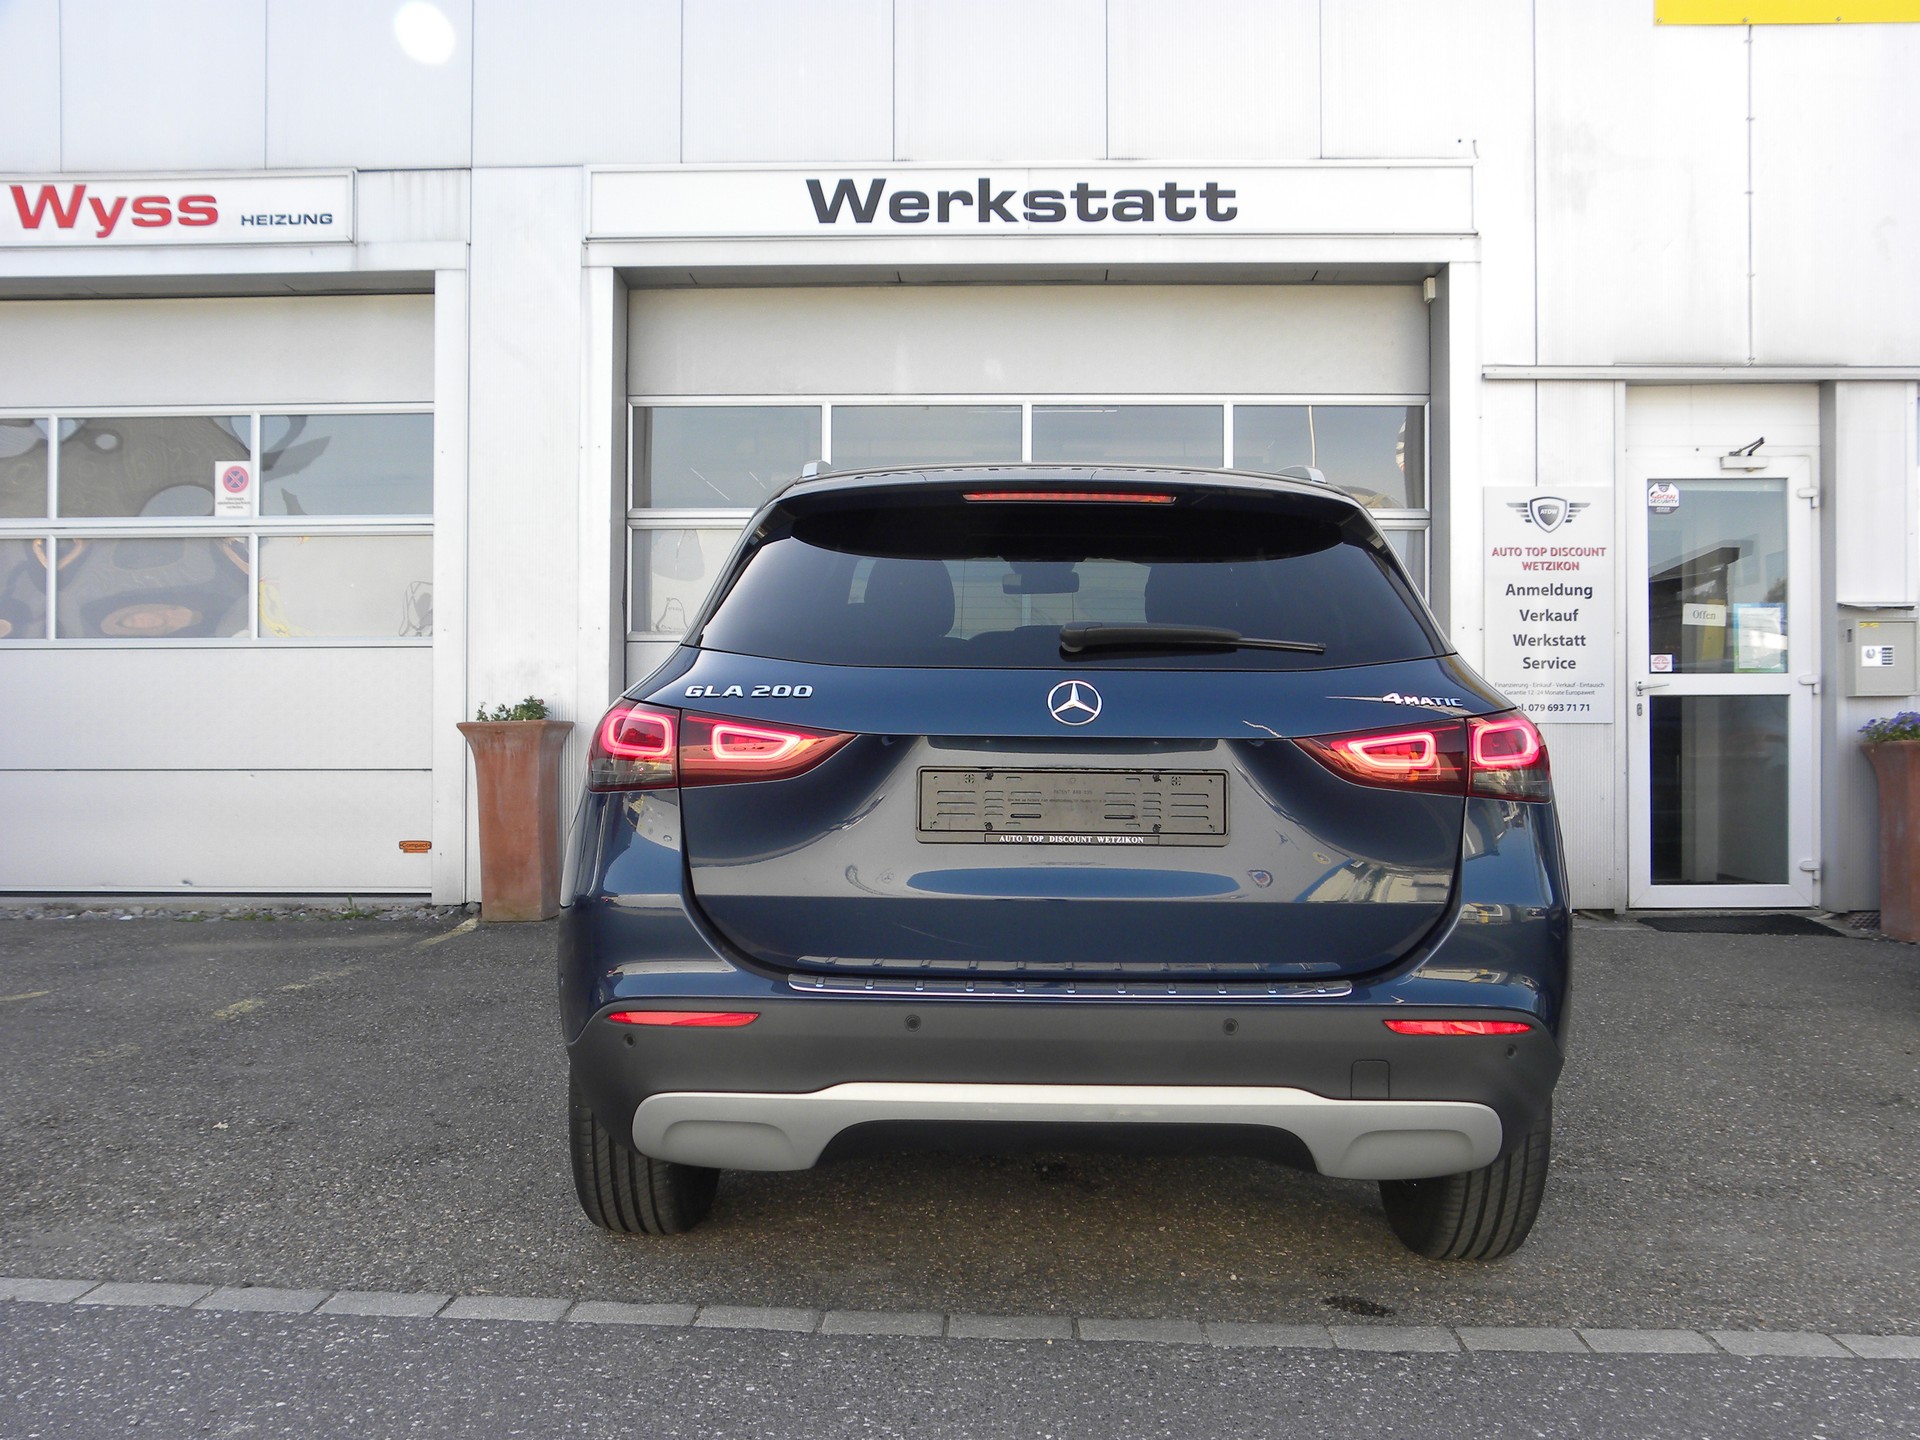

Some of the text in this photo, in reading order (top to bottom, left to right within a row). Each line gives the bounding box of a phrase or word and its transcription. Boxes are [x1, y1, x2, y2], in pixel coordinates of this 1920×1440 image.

[805, 178, 1238, 223] Werkstatt
[9, 184, 333, 238] Wyss HEIZUNG
[1492, 547, 1606, 556] AUTO TOP DISCOUNT
[1522, 561, 1580, 571] WETZIKON
[1505, 583, 1593, 599] Anmeldung
[1519, 609, 1579, 621] Verkauf
[1692, 610, 1716, 620] Offen
[1513, 634, 1586, 646] Werkstatt
[1522, 657, 1577, 669] Service
[684, 685, 813, 698] GLA 200
[1382, 692, 1463, 706] 4MATIC
[999, 835, 1022, 843] AUTO
[1097, 836, 1144, 844] WETZIKON
